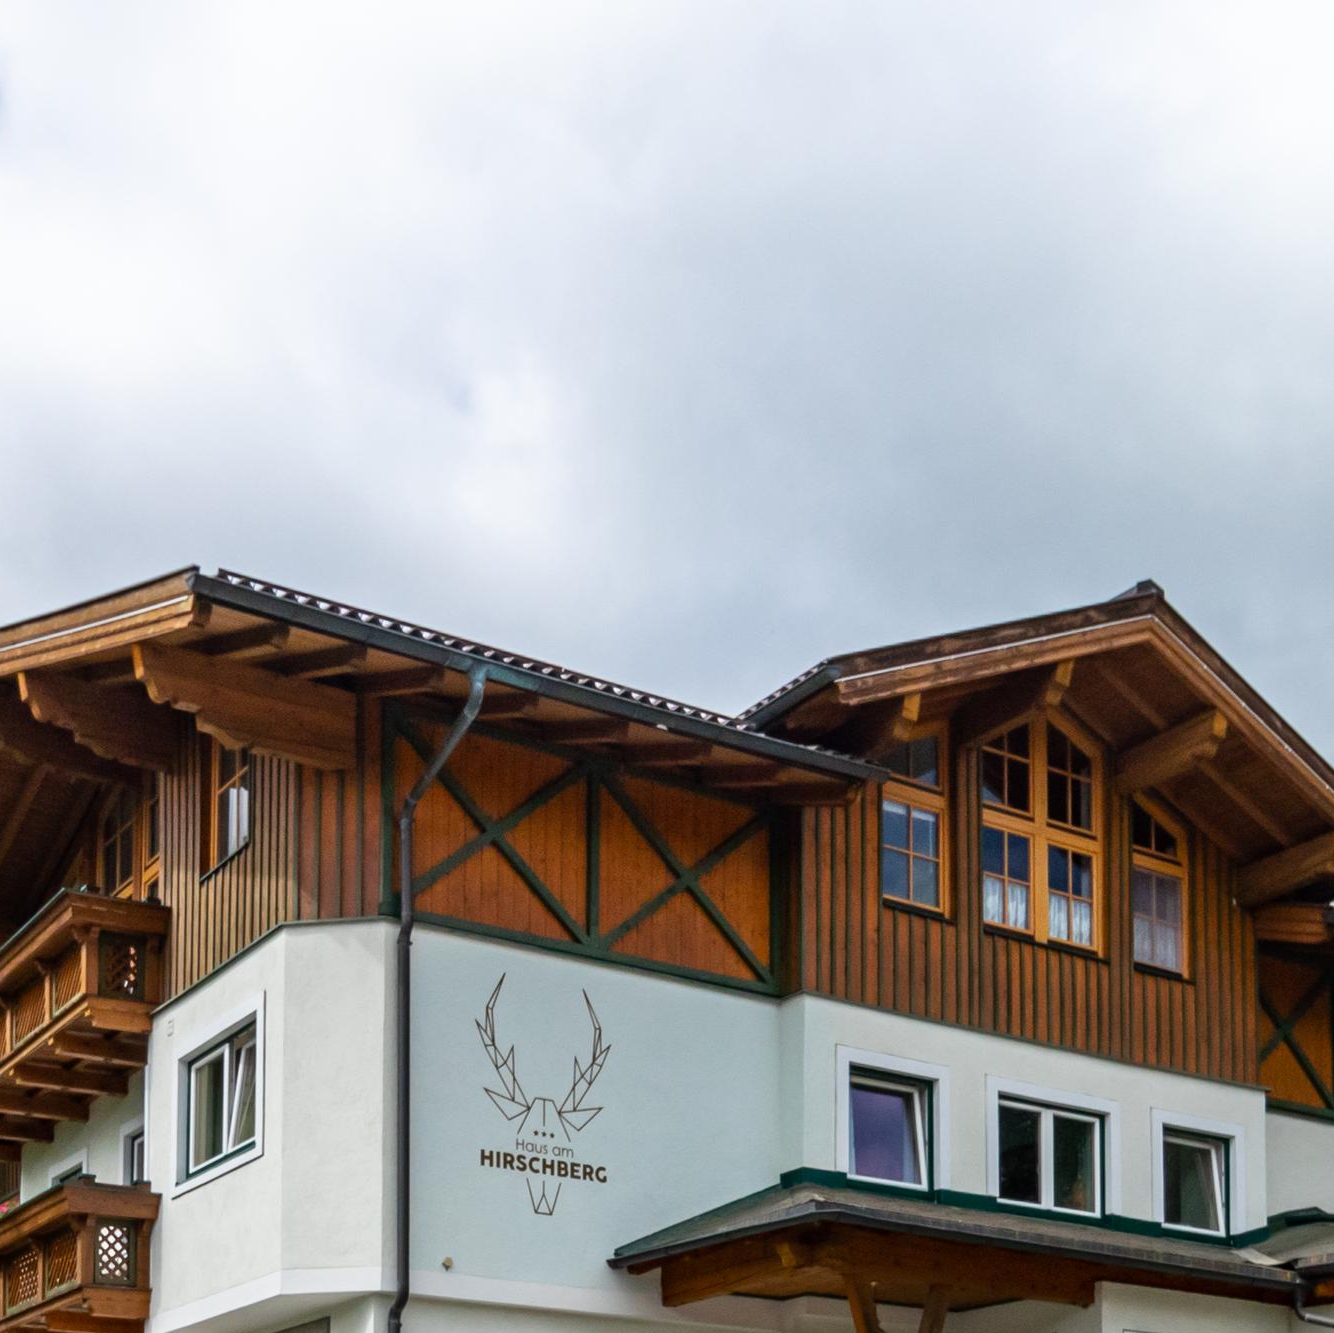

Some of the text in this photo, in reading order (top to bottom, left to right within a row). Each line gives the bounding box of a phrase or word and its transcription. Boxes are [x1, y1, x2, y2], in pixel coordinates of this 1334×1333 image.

[515, 1138, 575, 1158] Haus am
[480, 1149, 608, 1184] HIRSCHBERG
